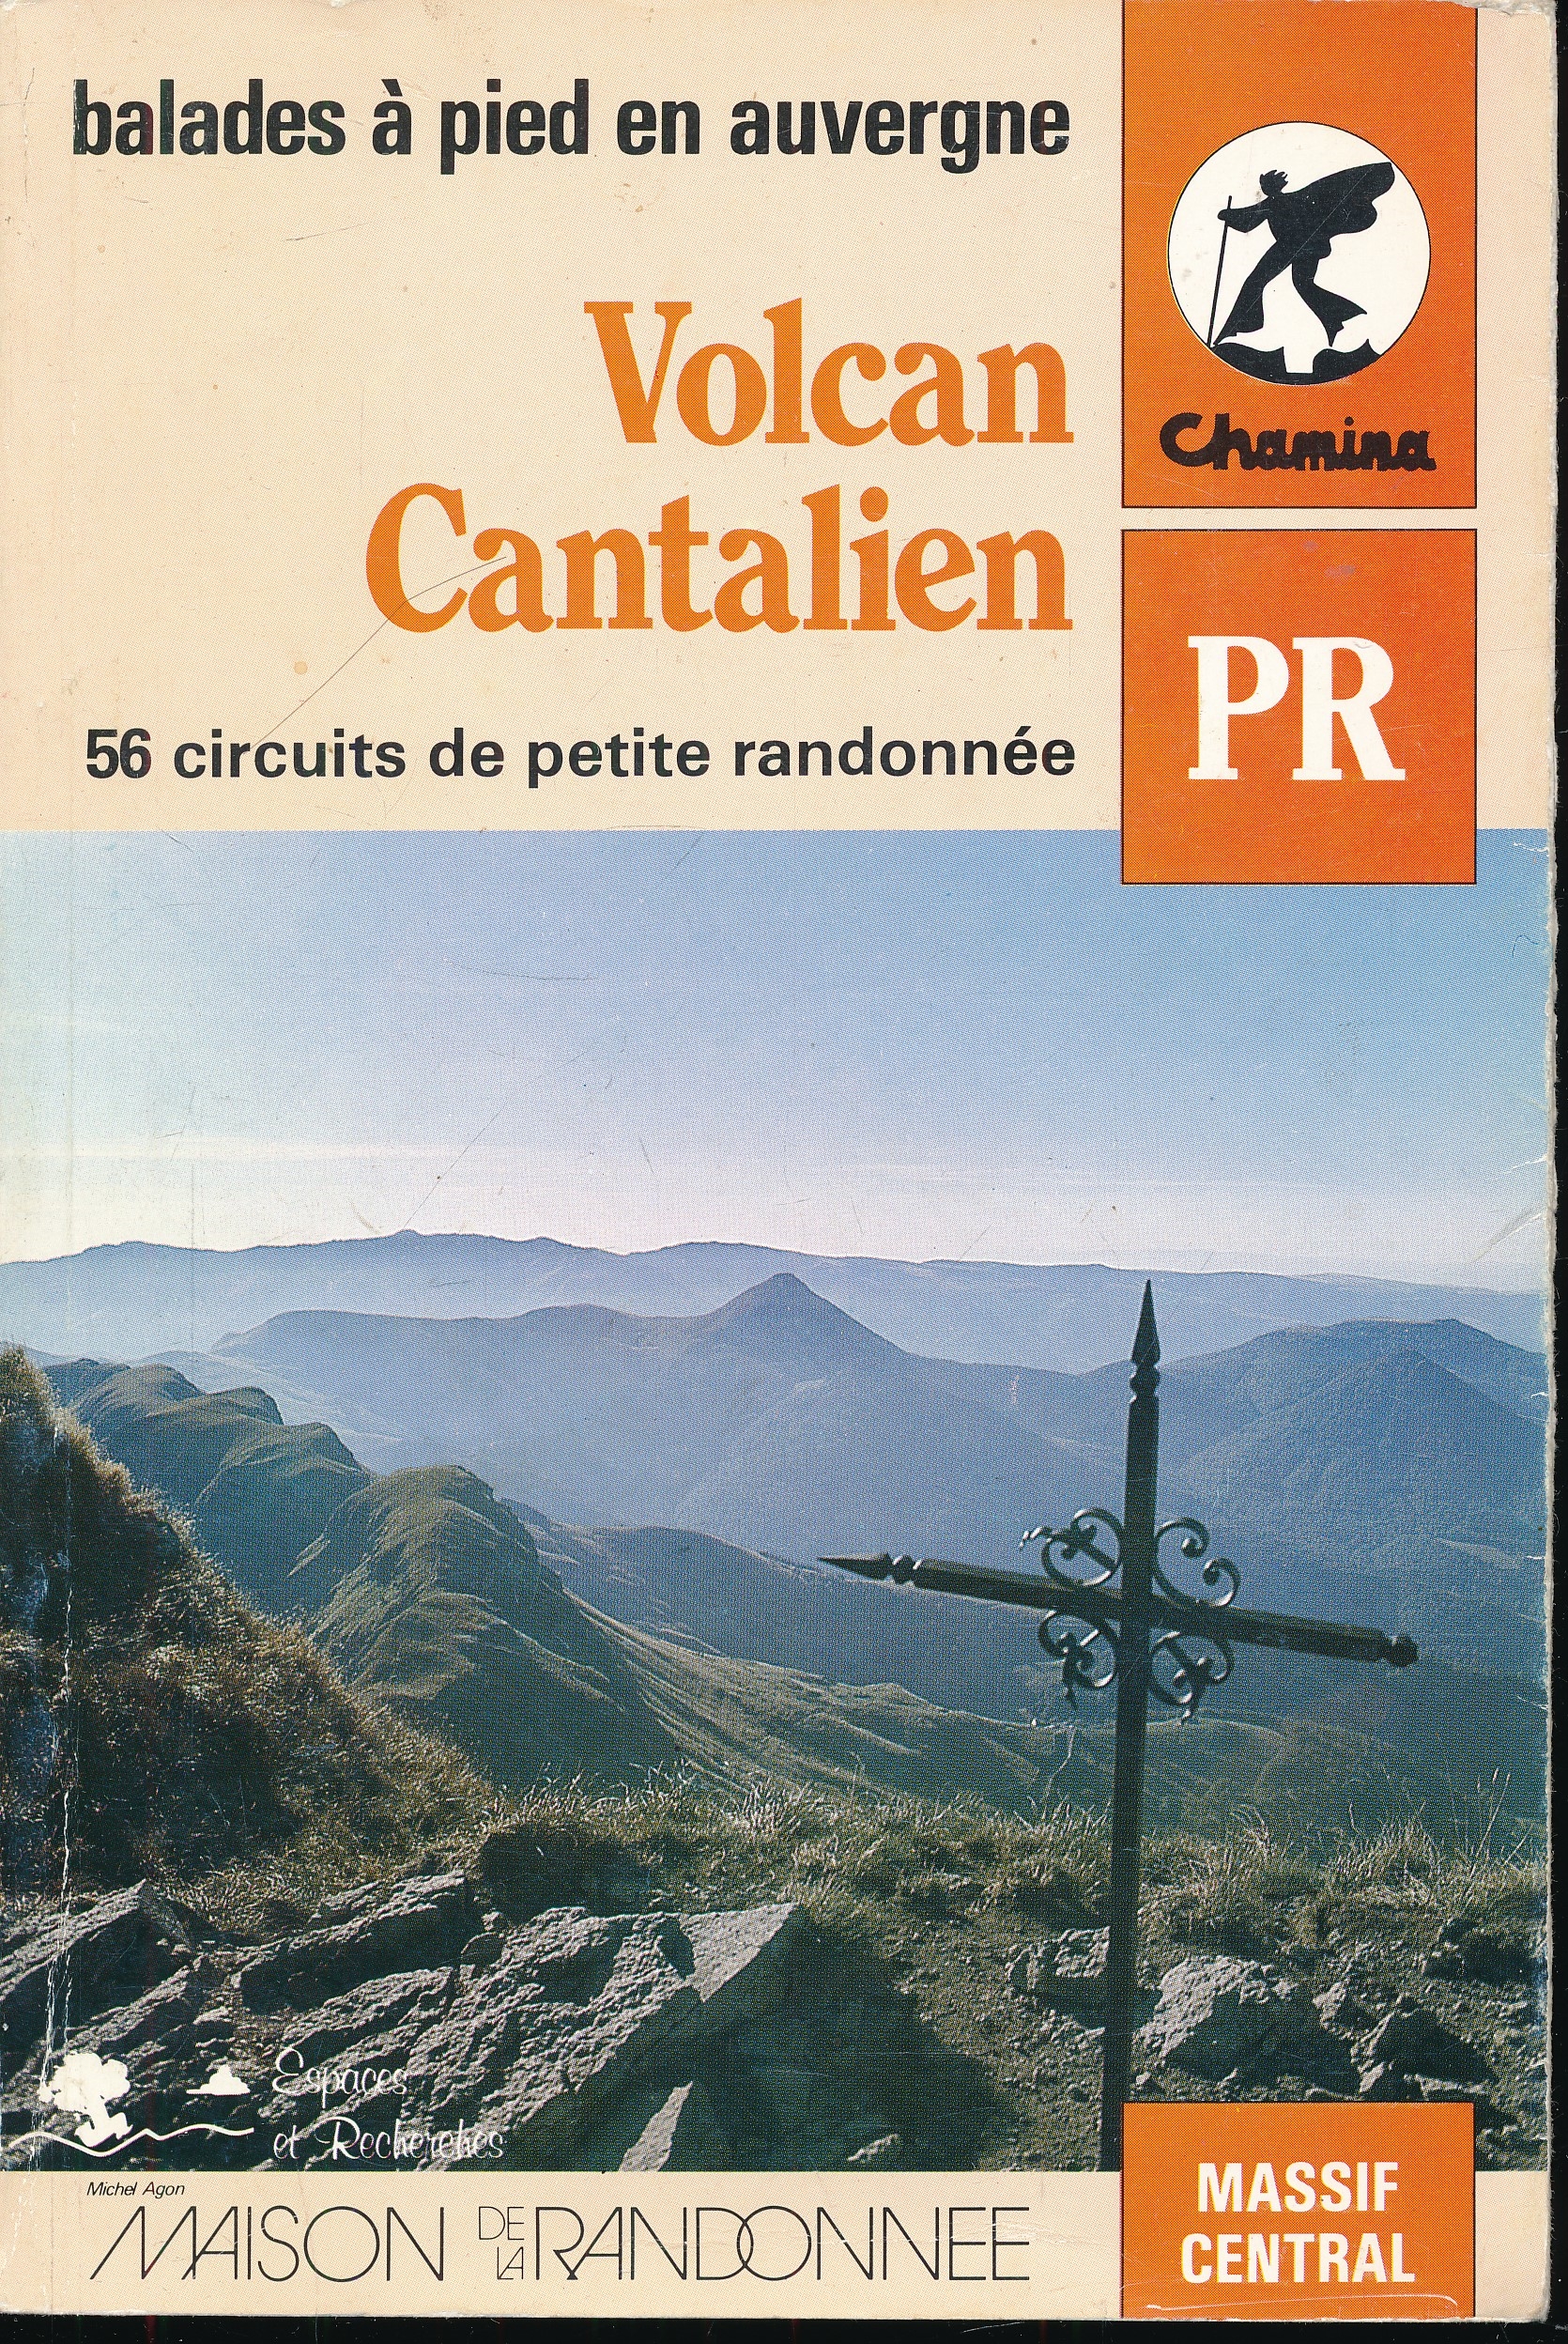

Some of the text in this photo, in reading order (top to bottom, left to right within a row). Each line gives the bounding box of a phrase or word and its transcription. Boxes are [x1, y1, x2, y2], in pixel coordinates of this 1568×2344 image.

[73, 79, 1070, 176] balades à pied en auvergne
[583, 297, 1074, 448] Volcan
[1160, 413, 1437, 472] Chamina
[365, 482, 1073, 634] Cantalien
[1187, 635, 1407, 782] PR
[85, 726, 1076, 790] 56 circuits de petite randonnée
[272, 2046, 408, 2109] Espaces
[273, 2124, 300, 2159] et
[86, 2182, 185, 2199] Michel Agon
[1197, 2161, 1399, 2213] MASSIF
[89, 2205, 1031, 2283] MAISON DE LA RANDONNEE
[1181, 2232, 1417, 2284] CENTRAL
